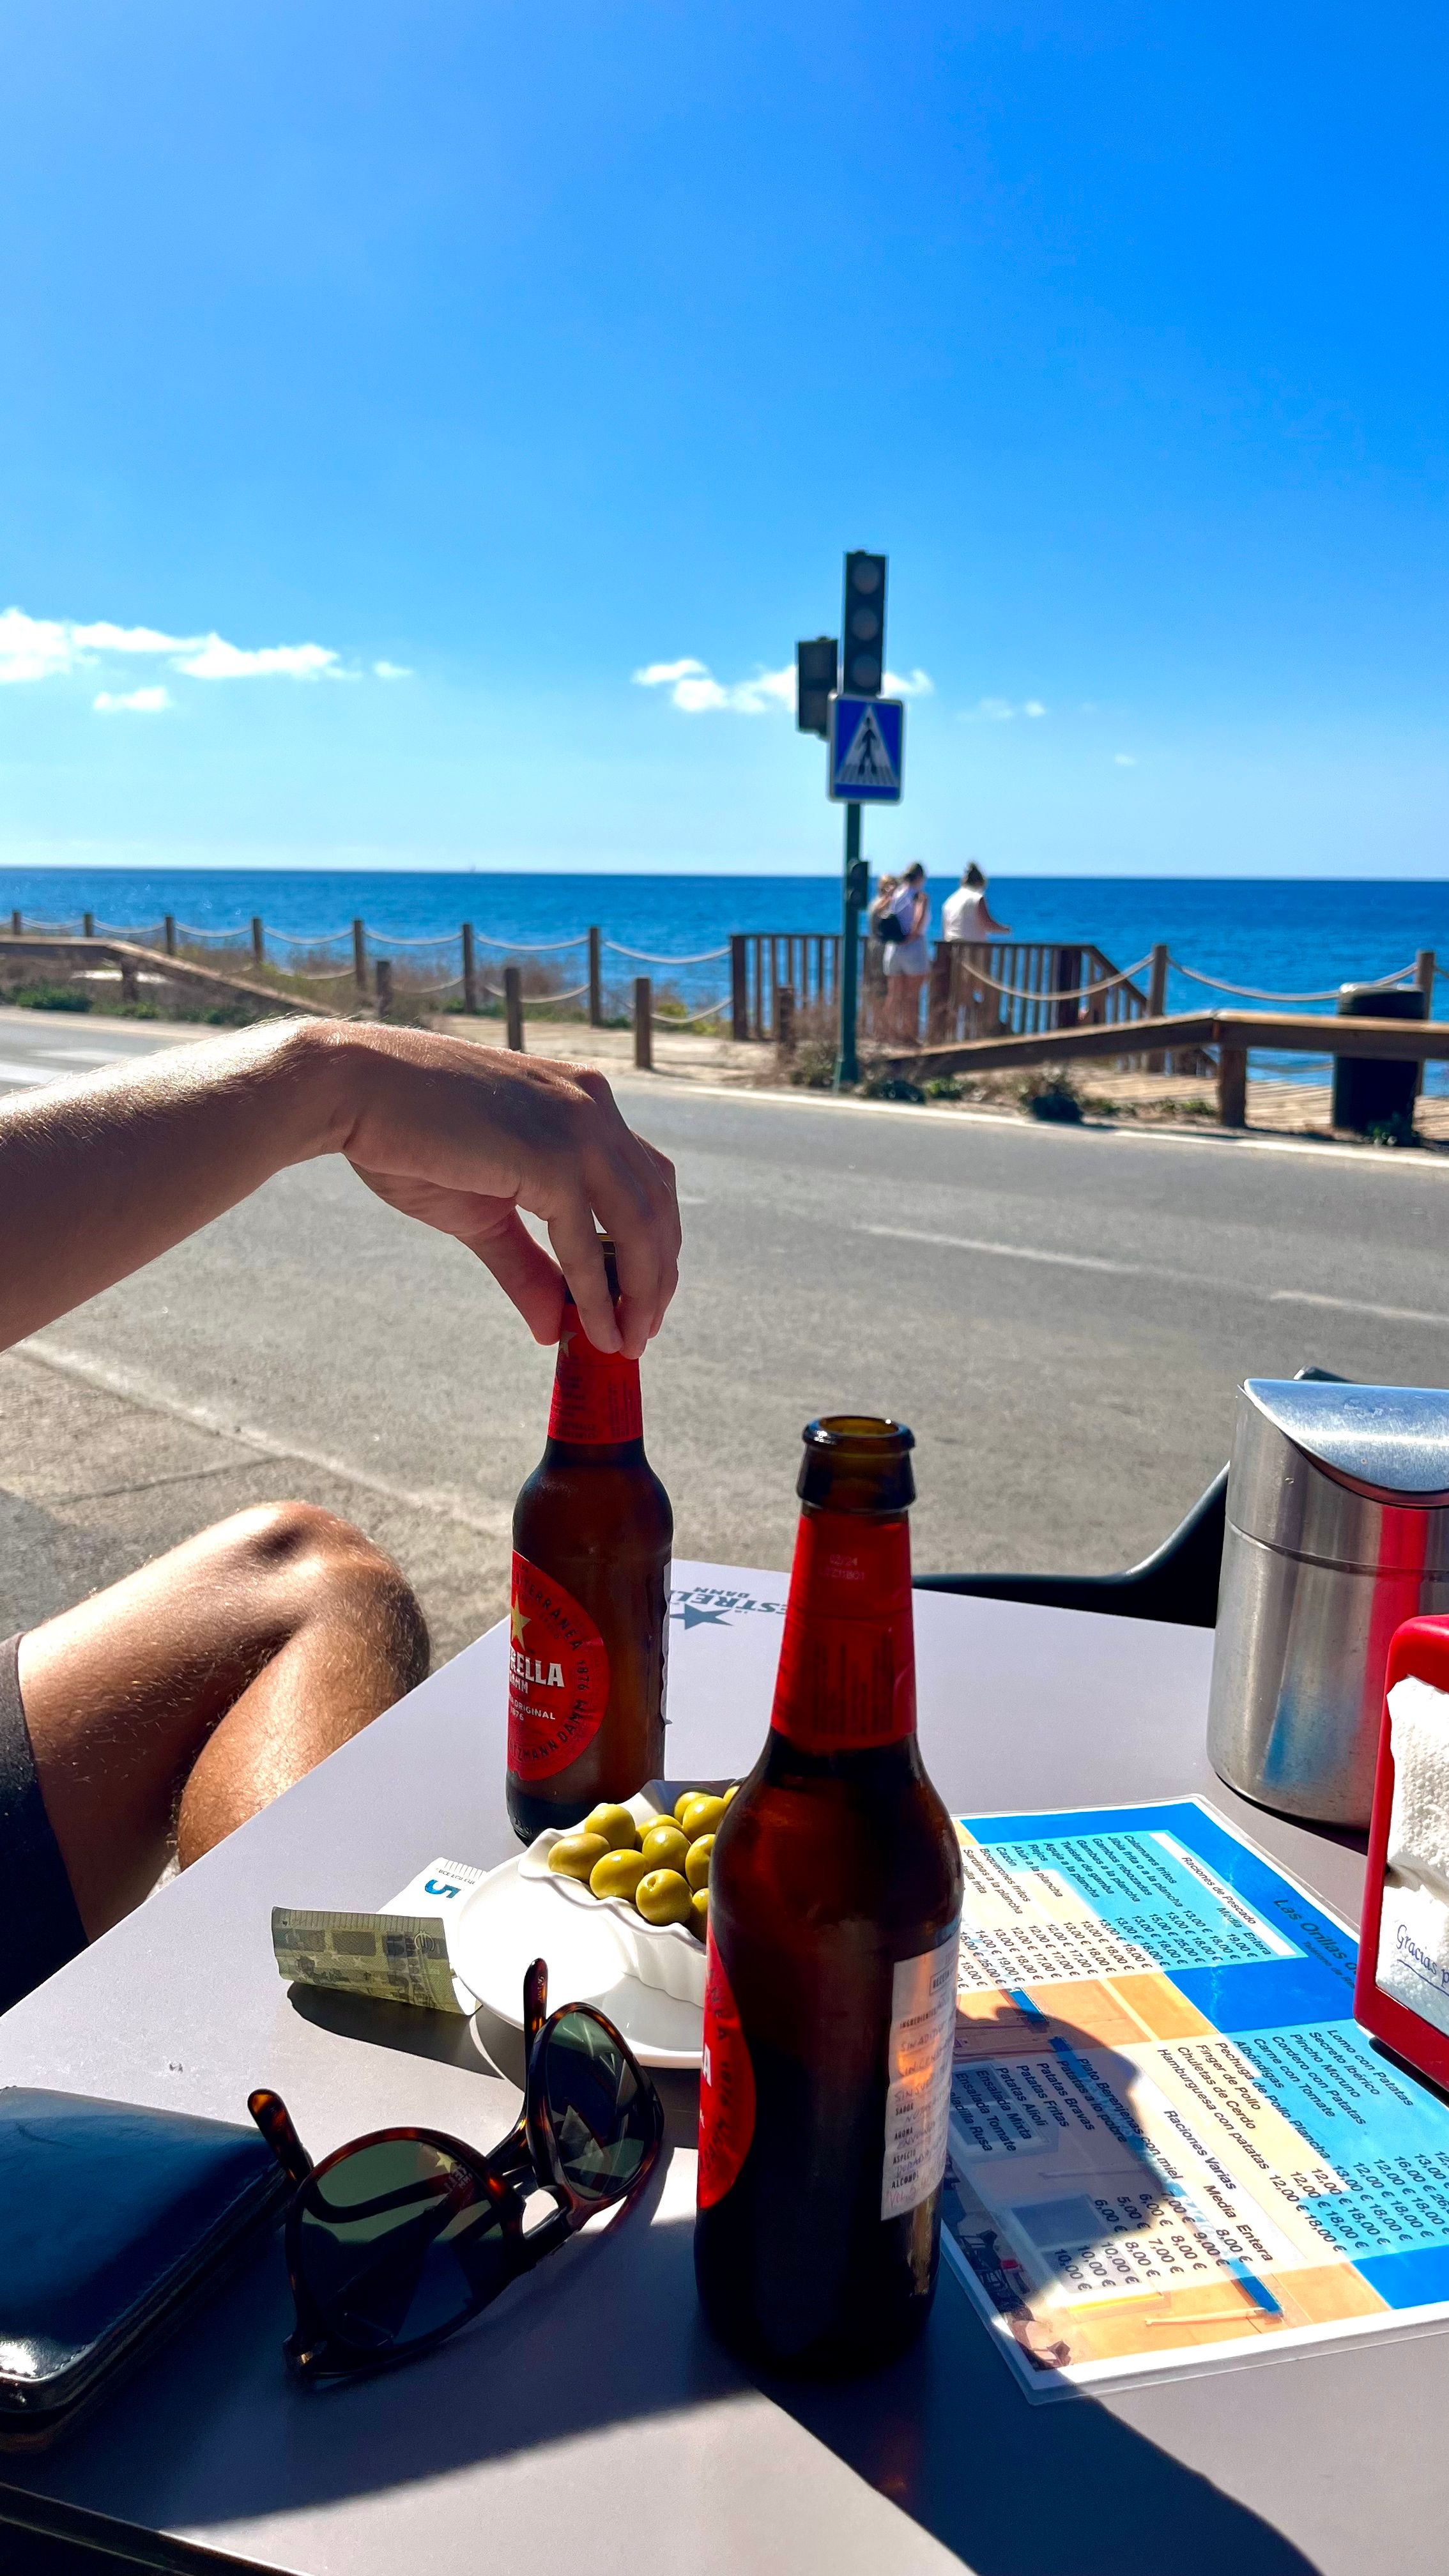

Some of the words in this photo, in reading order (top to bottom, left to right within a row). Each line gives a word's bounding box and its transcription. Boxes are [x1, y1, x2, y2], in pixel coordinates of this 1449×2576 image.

[694, 1587, 750, 1598] DAMM
[510, 1648, 565, 1687] RELLA
[514, 1699, 556, 1721] ORIGINAL
[556, 1699, 587, 1743] DAMM
[963, 1850, 990, 1876] Sardinas
[994, 1889, 1023, 1914] plancha
[979, 1848, 1015, 1884] Boquerones
[1012, 1885, 1031, 1902] fritos
[996, 1847, 1017, 1866] Cazón
[1011, 1846, 1029, 1860] Atún
[1034, 1873, 1063, 1897] plancha
[1027, 1844, 1048, 1861] Rejos
[1043, 1843, 1064, 1860] Aguja
[1070, 1873, 1100, 1897] plancha
[1061, 1841, 1085, 1862] Twister
[1081, 1864, 1093, 1872] de
[1087, 1873, 1114, 1894] gamba
[1076, 1839, 1104, 1864] Gambas
[1109, 1878, 1140, 1902] plancha
[1092, 1838, 1120, 1863] Gambas
[1116, 1864, 1153, 1896] rebozadas
[1122, 1851, 1139, 1864] frita
[1151, 1883, 1183, 1907] plancha
[1124, 1835, 1160, 1866] Calamares
[1156, 1867, 1177, 1883] fritos
[425, 1879, 461, 1899] 5
[972, 1880, 987, 1894] frita
[1181, 1857, 1215, 1885] Raciones
[1212, 1887, 1225, 1895] de
[1222, 1896, 1256, 1924] Pescado
[1046, 1924, 1068, 1941] 12,00
[1070, 1950, 1092, 1968] 17,00
[1183, 1910, 1206, 1927] 13,00
[1209, 1935, 1234, 1953] 18,00
[1216, 1908, 1242, 1928] Media
[1243, 1932, 1271, 1955] Entera
[1273, 1899, 1302, 1920] Las
[1300, 1922, 1347, 1959] Orillas
[1396, 1924, 1437, 1975] Gracias
[1056, 2060, 1089, 2094] Patatas
[1177, 2047, 1216, 2085] Chuletas
[1213, 2087, 1228, 2098] de
[1226, 2101, 1256, 2129] Cerdo
[1196, 2045, 1227, 2071] Finger
[1223, 2074, 1238, 2085] de
[1234, 2087, 1261, 2110] Pollo
[1233, 2041, 1284, 2088] Albóndigas
[1254, 2039, 1282, 2064] Carne
[1280, 2066, 1300, 2082] con
[1298, 2083, 1335, 2117] Tomate
[1272, 2036, 1310, 2070] Cordero
[1308, 2072, 1329, 2089] con
[1326, 2090, 1366, 2124] Patatas
[1290, 2034, 1324, 2062] Pincho
[1321, 2064, 1360, 2097] Moruno
[1309, 2032, 1346, 2064] Secreto
[1344, 2065, 1380, 2094] Ibérico
[1327, 2030, 1356, 2053] Lomo
[1354, 2055, 1376, 2071] con
[1372, 2072, 1413, 2106] Patatas
[955, 2073, 990, 2114] Ensalada
[986, 2115, 1016, 2151] Tomate
[976, 2070, 1011, 2111] Ensalada
[1006, 2113, 1032, 2140] Mixta
[994, 2067, 1027, 2101] Patatas
[1022, 2104, 1048, 2126] Alioli
[1016, 2065, 1048, 2099] Patatas
[1043, 2100, 1070, 2127] Fritas
[1036, 2063, 1068, 2096] Patatas
[1064, 2098, 1095, 2130] Bravas
[1078, 2058, 1100, 2080] Plato
[1096, 2082, 1144, 2135] Berenjenas
[1142, 2137, 1161, 2156] con
[1157, 2158, 1184, 2179] miel
[1091, 2103, 1104, 2112] lo
[1157, 2049, 1216, 2110] Hamburguesa
[1214, 2112, 1234, 2130] con
[1228, 2133, 1269, 2169] patatas
[1215, 2043, 1255, 2080] Pechuga
[1252, 2082, 1268, 2093] de
[1264, 2095, 1291, 2118] Pollo
[1289, 2120, 1331, 2159] Plancha
[894, 2126, 914, 2140] AROMA
[969, 2126, 993, 2151] Rusa
[1096, 2114, 1127, 2142] pobre
[1163, 2110, 1208, 2156] Raciones
[1205, 2157, 1236, 2189] Varias
[1140, 2194, 1165, 2216] 6,00
[1171, 2235, 1198, 2259] 8,00
[1203, 2185, 1236, 2218] Media
[1236, 2225, 1273, 2261] Entera
[1269, 2175, 1300, 2202] 12,00
[1305, 2214, 1337, 2242] 18,00
[1291, 2172, 1321, 2198] 12,00
[1325, 2211, 1359, 2239] 18,00
[1312, 2168, 1342, 2195] 12,00
[1347, 2207, 1381, 2235] 18,00
[1333, 2165, 1363, 2191] 13,00
[1369, 2204, 1402, 2231] 18,00
[1094, 2200, 1119, 2222] 6,00
[1125, 2242, 1152, 2266] 8,00
[1117, 2196, 1142, 2219] 5,00
[1148, 2238, 1175, 2262] 7,00
[1216, 2229, 1243, 2253] 8,00
[1101, 2242, 1131, 2273] 10,00
[1124, 2276, 1140, 2284] €
